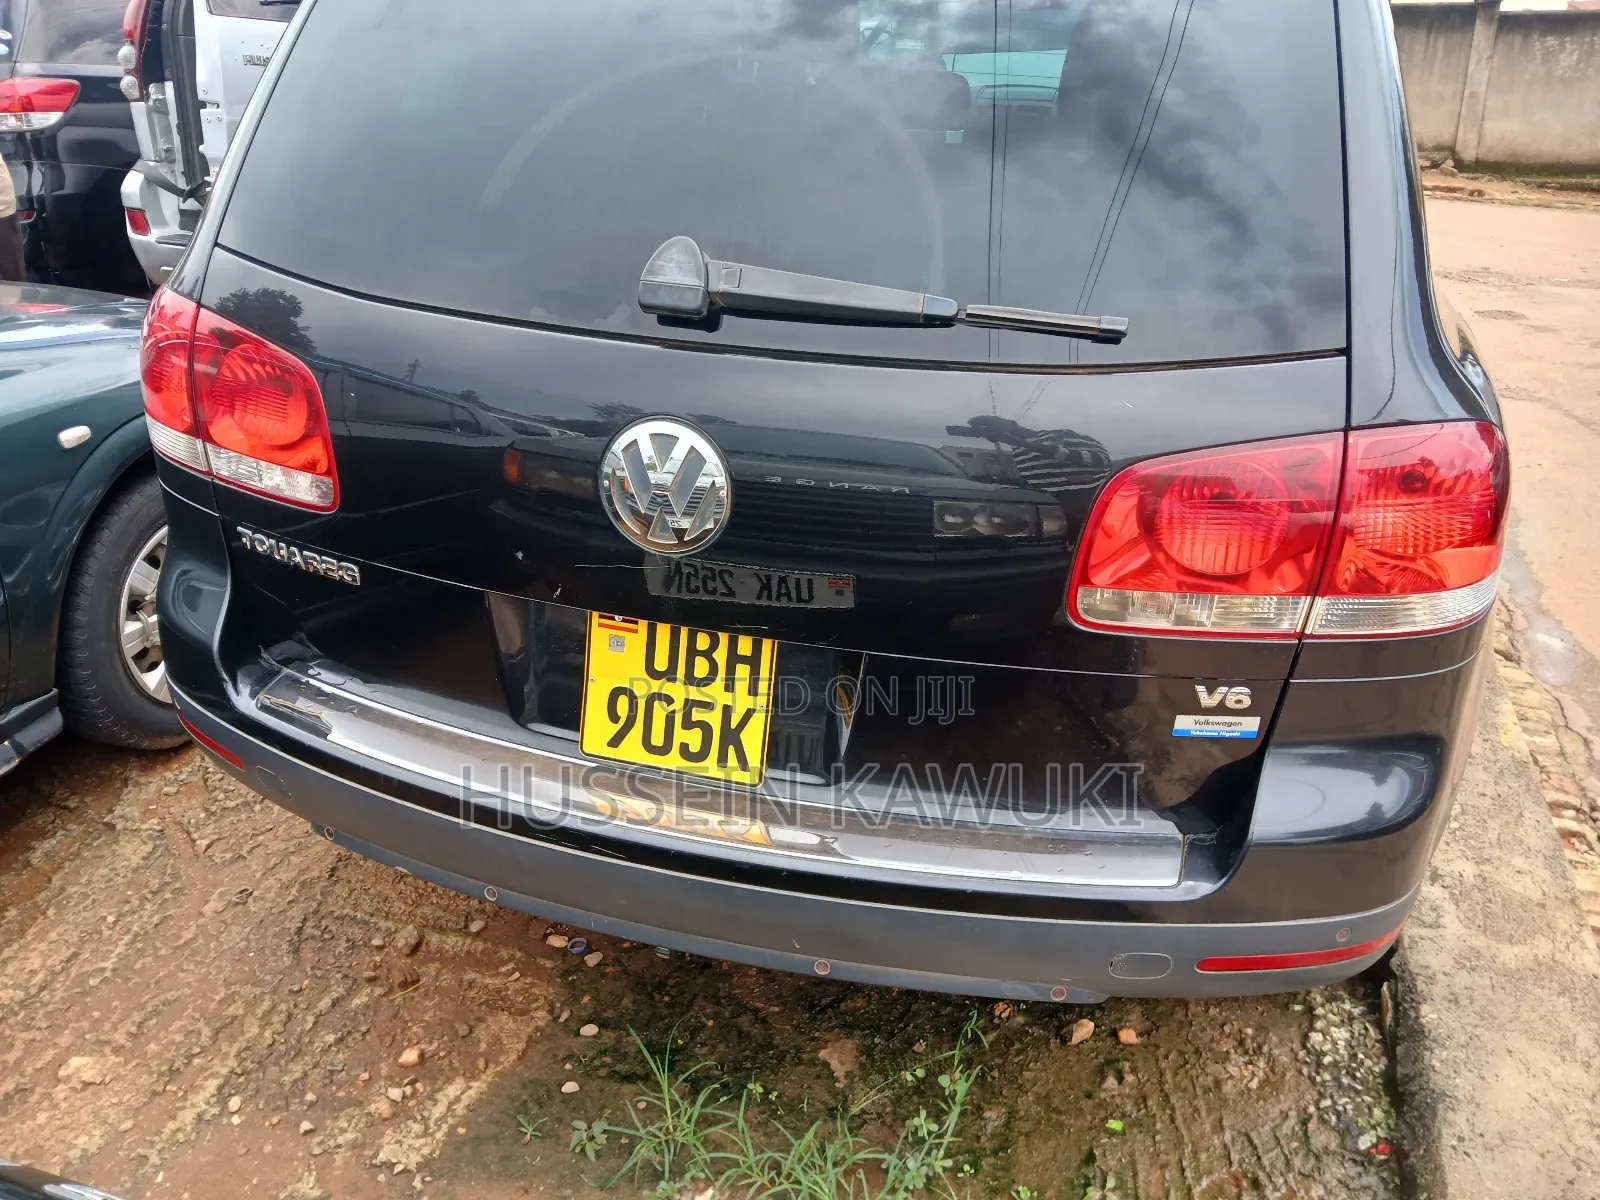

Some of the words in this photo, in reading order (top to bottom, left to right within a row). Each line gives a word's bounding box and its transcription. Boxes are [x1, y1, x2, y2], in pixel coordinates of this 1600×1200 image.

[243, 54, 271, 66] RUS
[236, 526, 361, 586] TOUAREG
[644, 621, 764, 698] UBH
[1194, 684, 1252, 710] V6
[606, 685, 759, 773] 905K
[1193, 718, 1243, 728] Volkswagen
